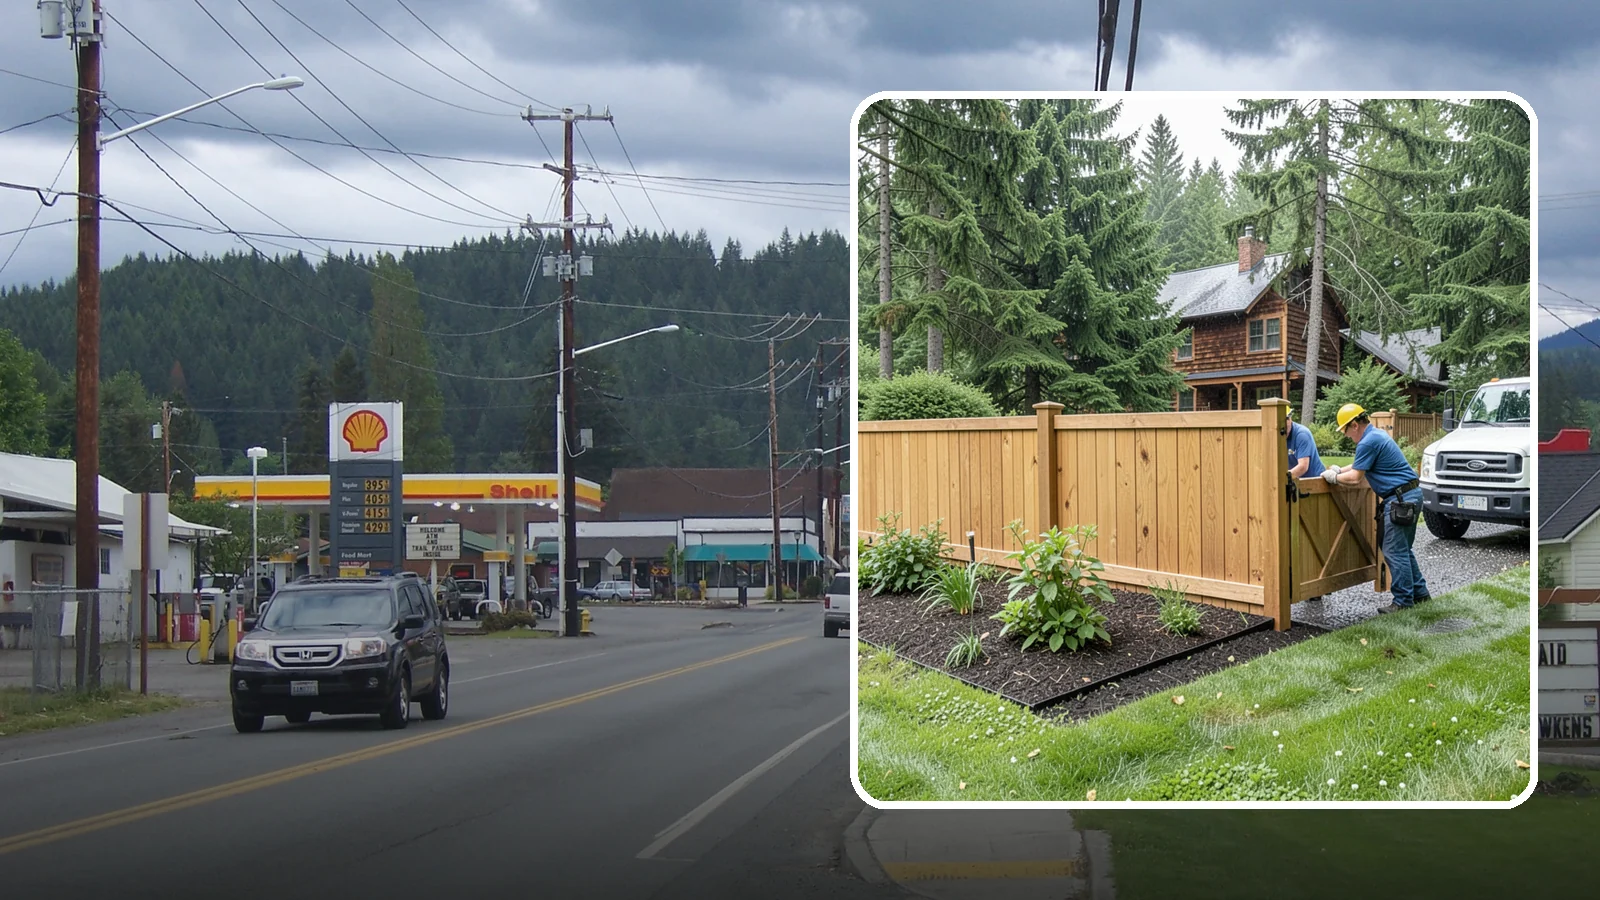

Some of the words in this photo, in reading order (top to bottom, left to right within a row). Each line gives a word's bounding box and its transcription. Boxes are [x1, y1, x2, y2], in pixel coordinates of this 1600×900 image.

[366, 480, 383, 490] 395
[490, 484, 547, 499] Shell
[366, 494, 383, 504] 405
[366, 508, 383, 518] 415
[366, 522, 383, 532] 429
